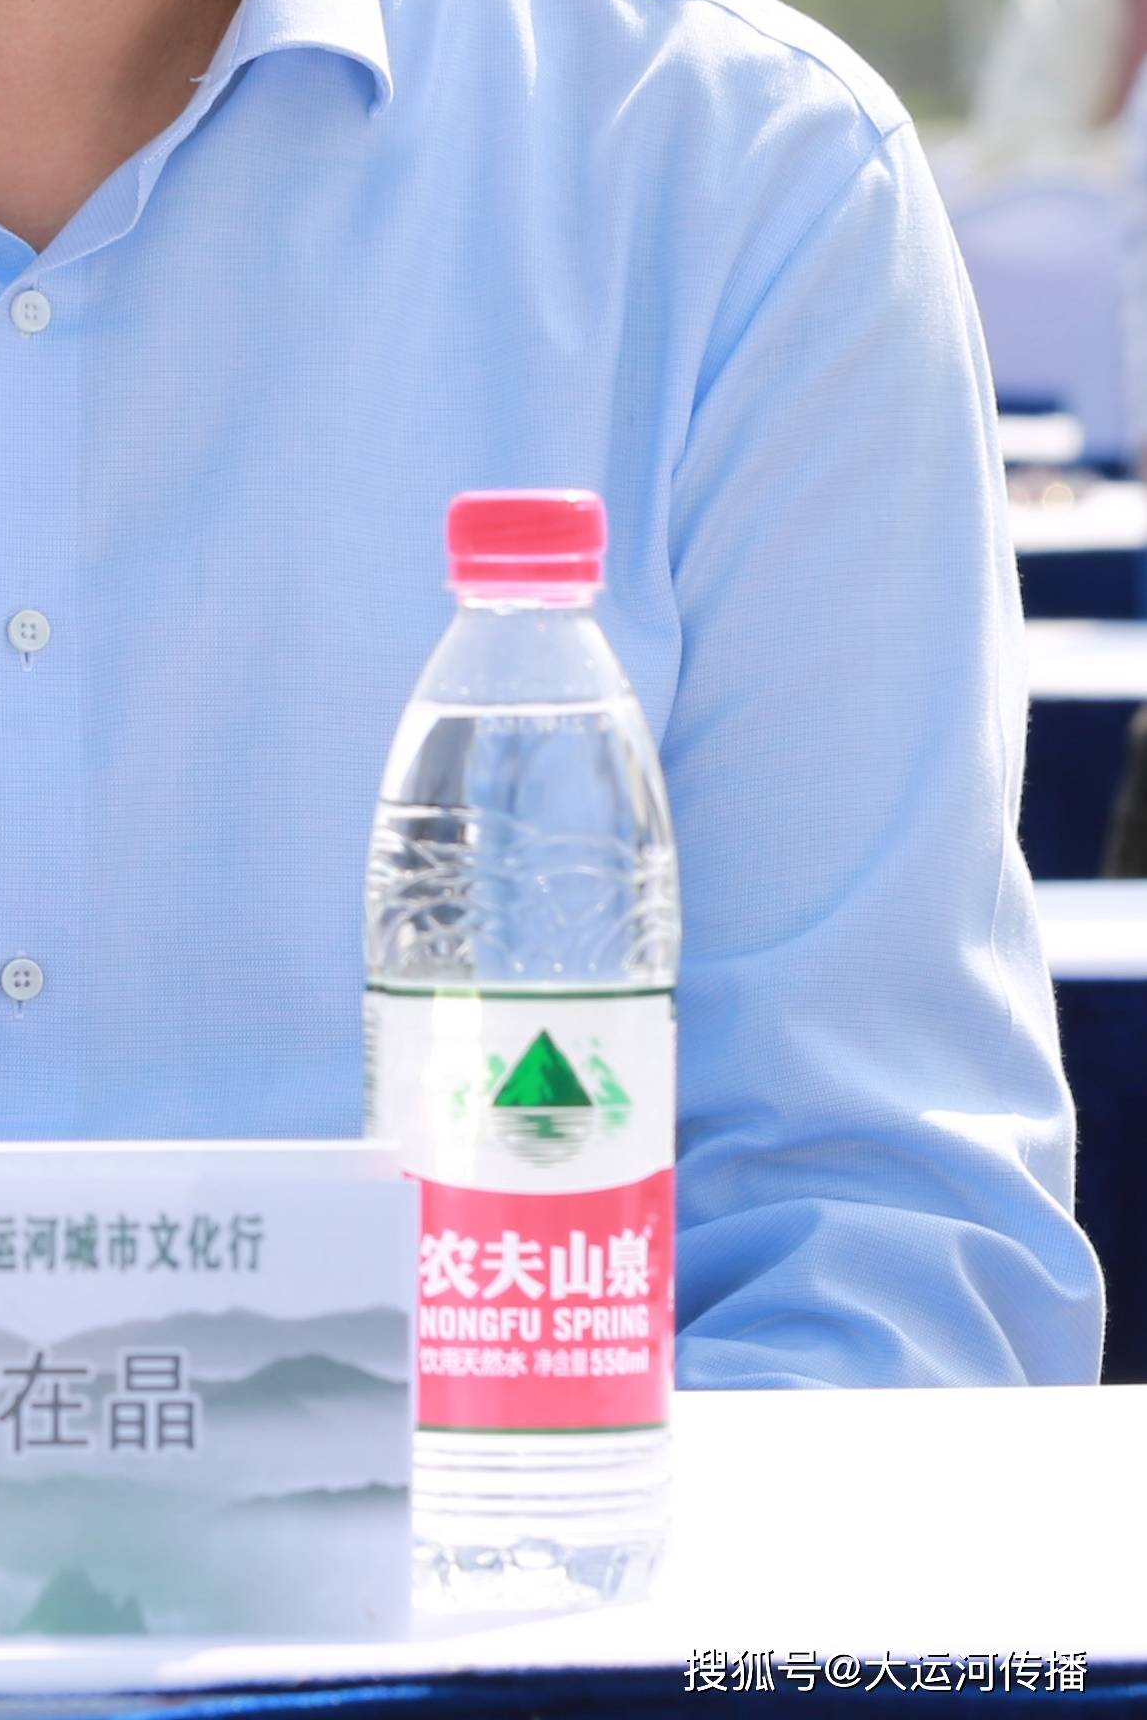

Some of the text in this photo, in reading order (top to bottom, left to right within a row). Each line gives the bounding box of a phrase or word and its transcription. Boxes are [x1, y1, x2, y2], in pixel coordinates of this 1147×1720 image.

[420, 1228, 651, 1300] 农夫山泉
[420, 1303, 650, 1343] NONGFU SPRING
